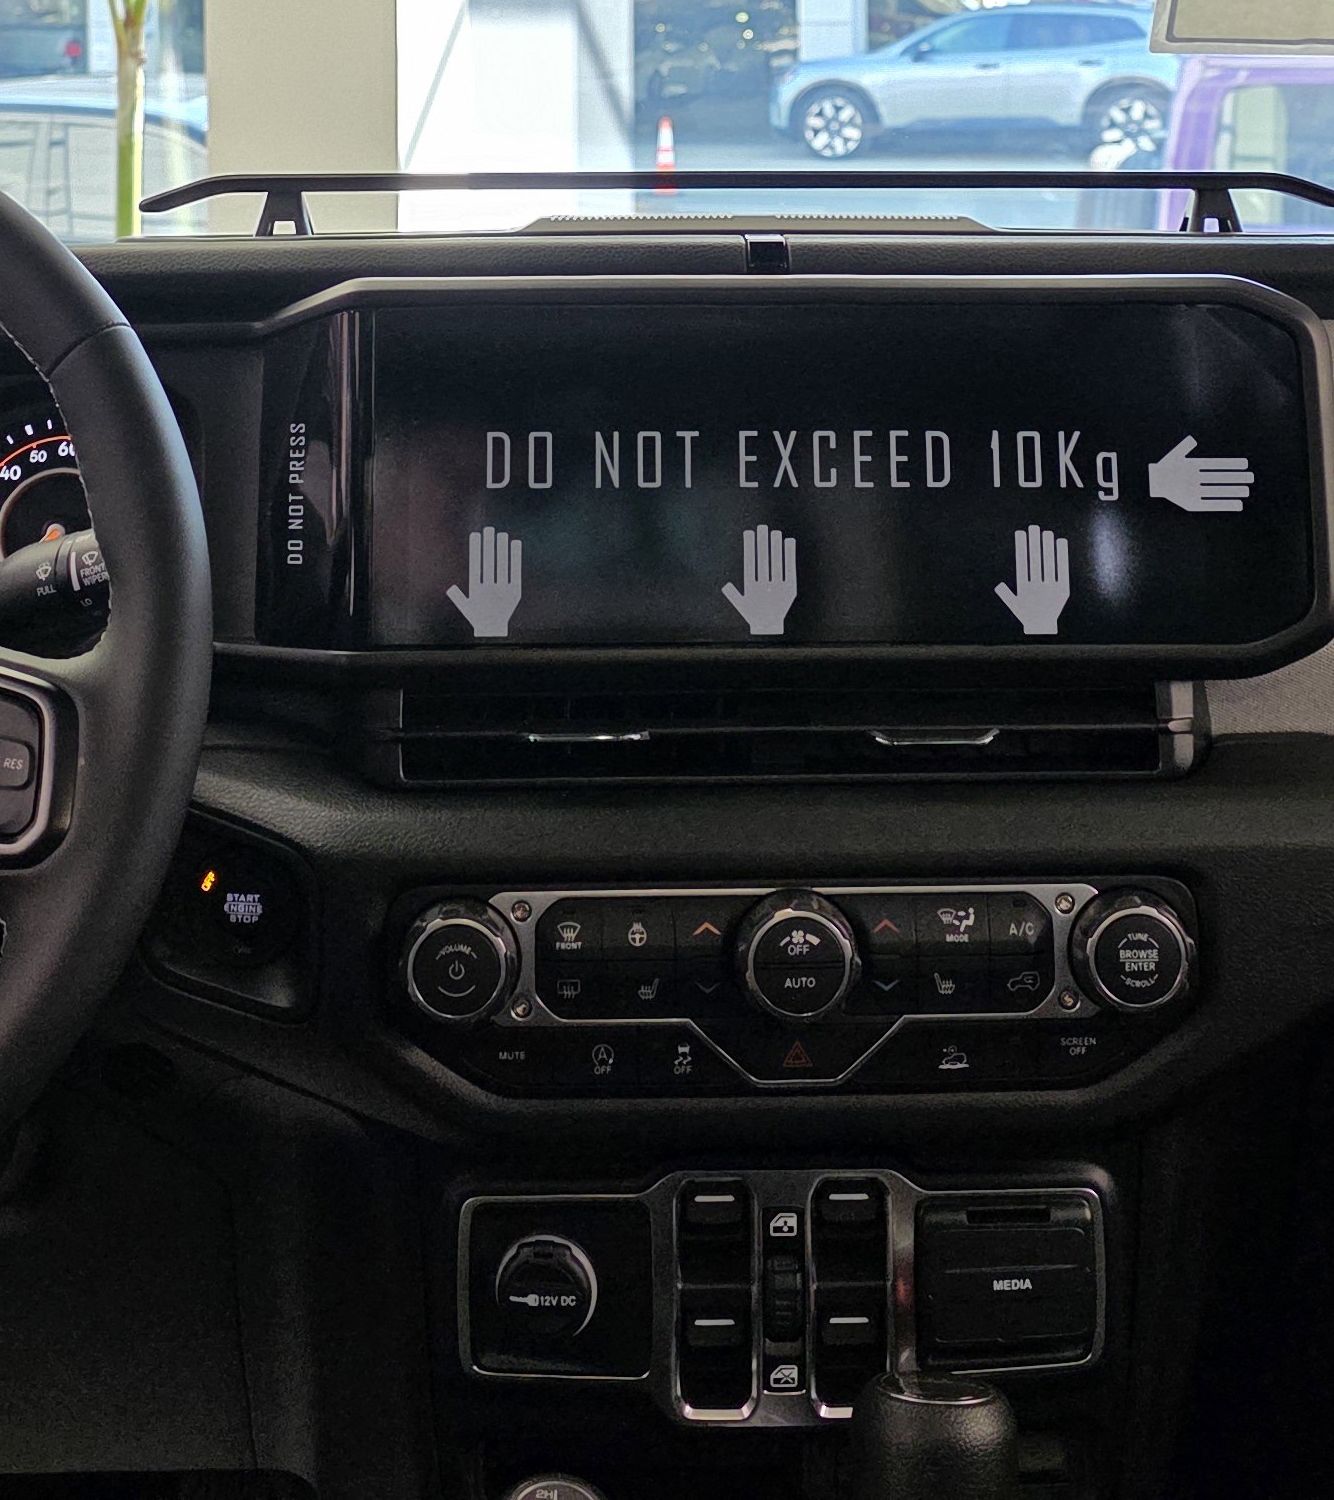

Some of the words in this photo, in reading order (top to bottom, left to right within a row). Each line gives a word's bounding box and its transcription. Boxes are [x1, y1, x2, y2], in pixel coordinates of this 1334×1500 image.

[29, 450, 48, 463] 50
[288, 422, 307, 485] PRESS
[484, 429, 554, 490] DO
[593, 429, 700, 490] NOT
[737, 429, 952, 490] EXCEED
[989, 429, 1120, 501] 10Kg
[0, 465, 22, 481] 40
[287, 492, 305, 531] NOT
[286, 539, 304, 566] DO
[36, 585, 58, 597] PULL
[2, 757, 24, 771] RES
[226, 892, 261, 903] START
[229, 915, 259, 924] STOP
[1008, 922, 1035, 937] A/C
[945, 934, 970, 943] MODE
[1126, 932, 1150, 943] TUNE
[438, 943, 473, 957] VOLUME
[555, 941, 583, 951] FRONT
[787, 944, 810, 956] OFF
[1119, 948, 1160, 960] BROWSE
[1124, 961, 1156, 972] ENTER
[784, 976, 816, 989] AUTO
[1124, 976, 1157, 989] SCROLL
[1060, 1037, 1098, 1047] SCREEN
[498, 1051, 527, 1062] MUTE
[1069, 1046, 1088, 1056] OFF
[593, 1065, 612, 1076] OFF
[673, 1065, 693, 1076] OFF
[992, 1277, 1034, 1292] MEDIA
[539, 1294, 559, 1308] 12V
[560, 1294, 577, 1308] DC
[535, 1488, 554, 1500] 2H
